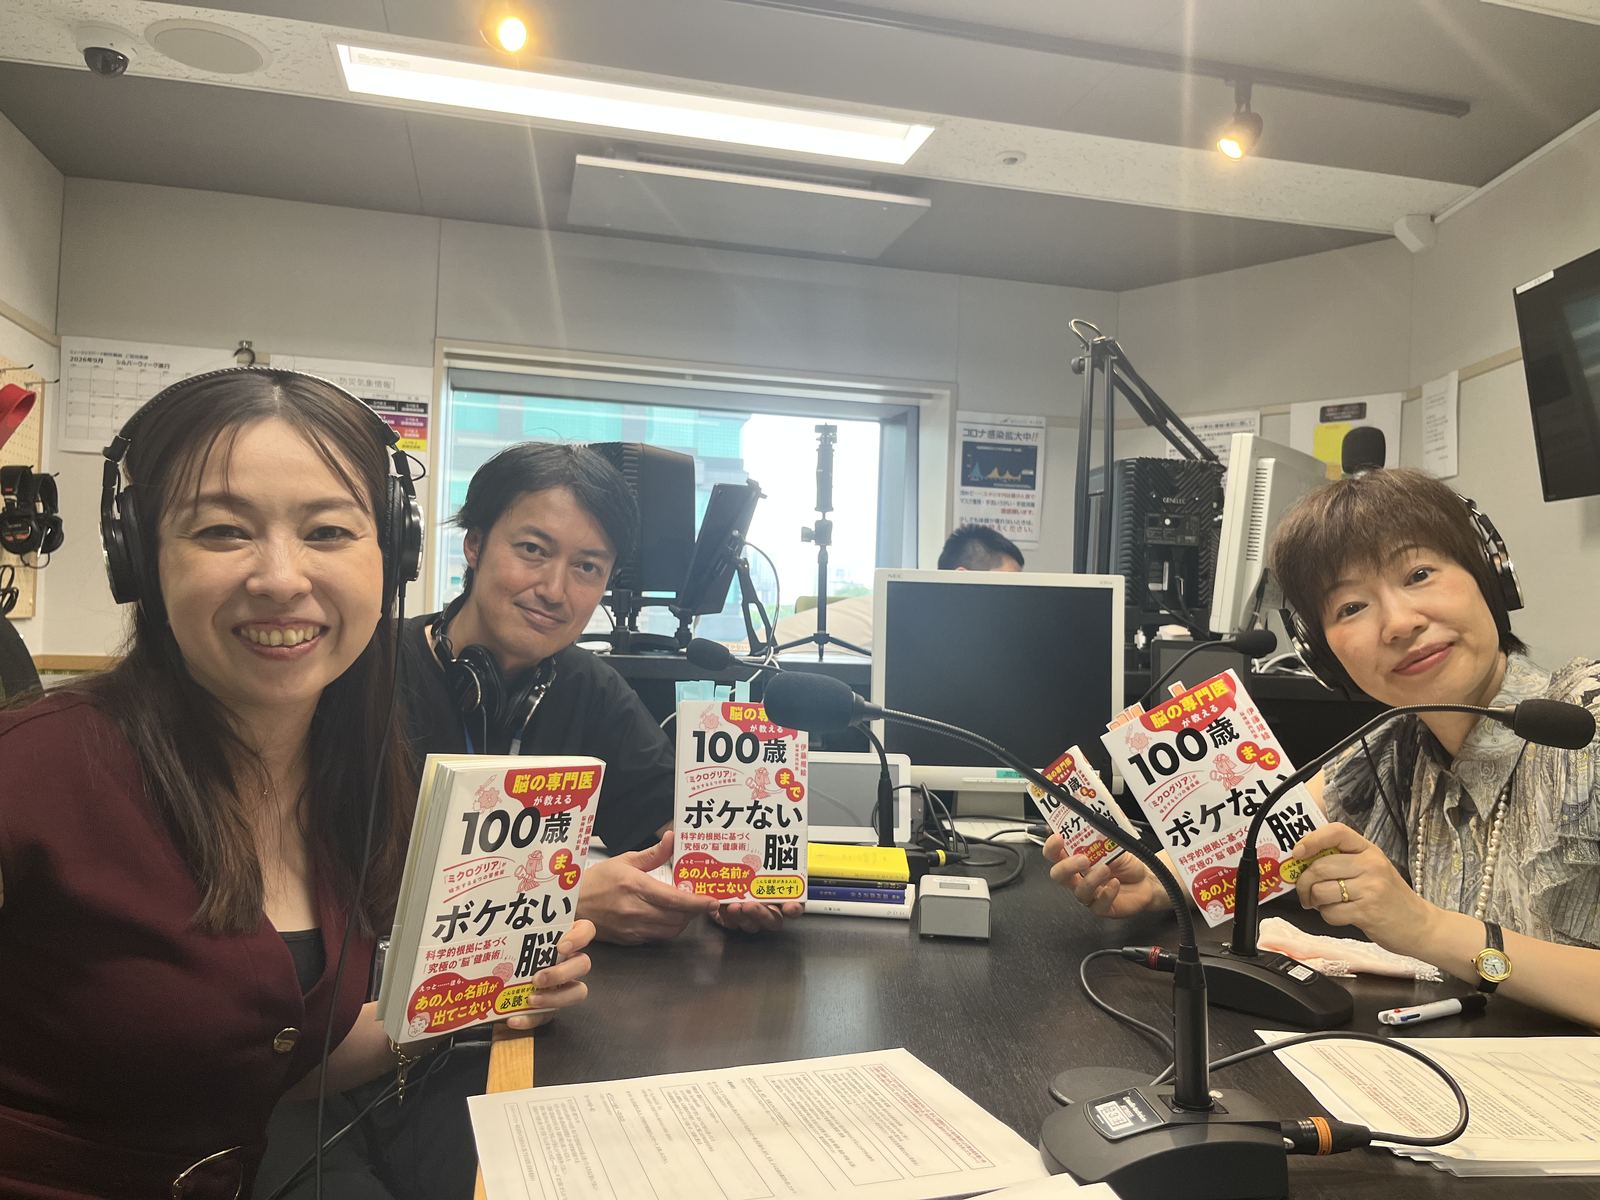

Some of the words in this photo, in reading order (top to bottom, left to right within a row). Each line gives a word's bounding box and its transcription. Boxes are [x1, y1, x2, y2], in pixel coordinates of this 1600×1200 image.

[1149, 679, 1230, 728] 脳の専門医
[1181, 704, 1219, 728] が教える
[749, 724, 784, 734] が教える
[692, 731, 787, 764] 100歳
[1128, 716, 1240, 786] 100歳
[1241, 746, 1277, 765] まで
[512, 770, 595, 794] 脳の専門医
[780, 772, 801, 798] まで
[533, 794, 572, 806] が教える
[684, 798, 803, 829] ボケない
[461, 806, 572, 855] 100歳
[680, 832, 751, 841] 科学的根拠に基づく
[1265, 802, 1317, 853] 脳
[763, 834, 800, 871] 脳
[554, 854, 577, 885] まで
[678, 866, 751, 880] あの人の名前が
[694, 882, 748, 896] 出てこない
[432, 892, 573, 943] ボケない
[425, 936, 508, 961] 科学的根拠に基づく
[514, 930, 564, 978] 脳
[415, 981, 498, 1011] あの人の名前が
[431, 998, 492, 1027] 出てこない
